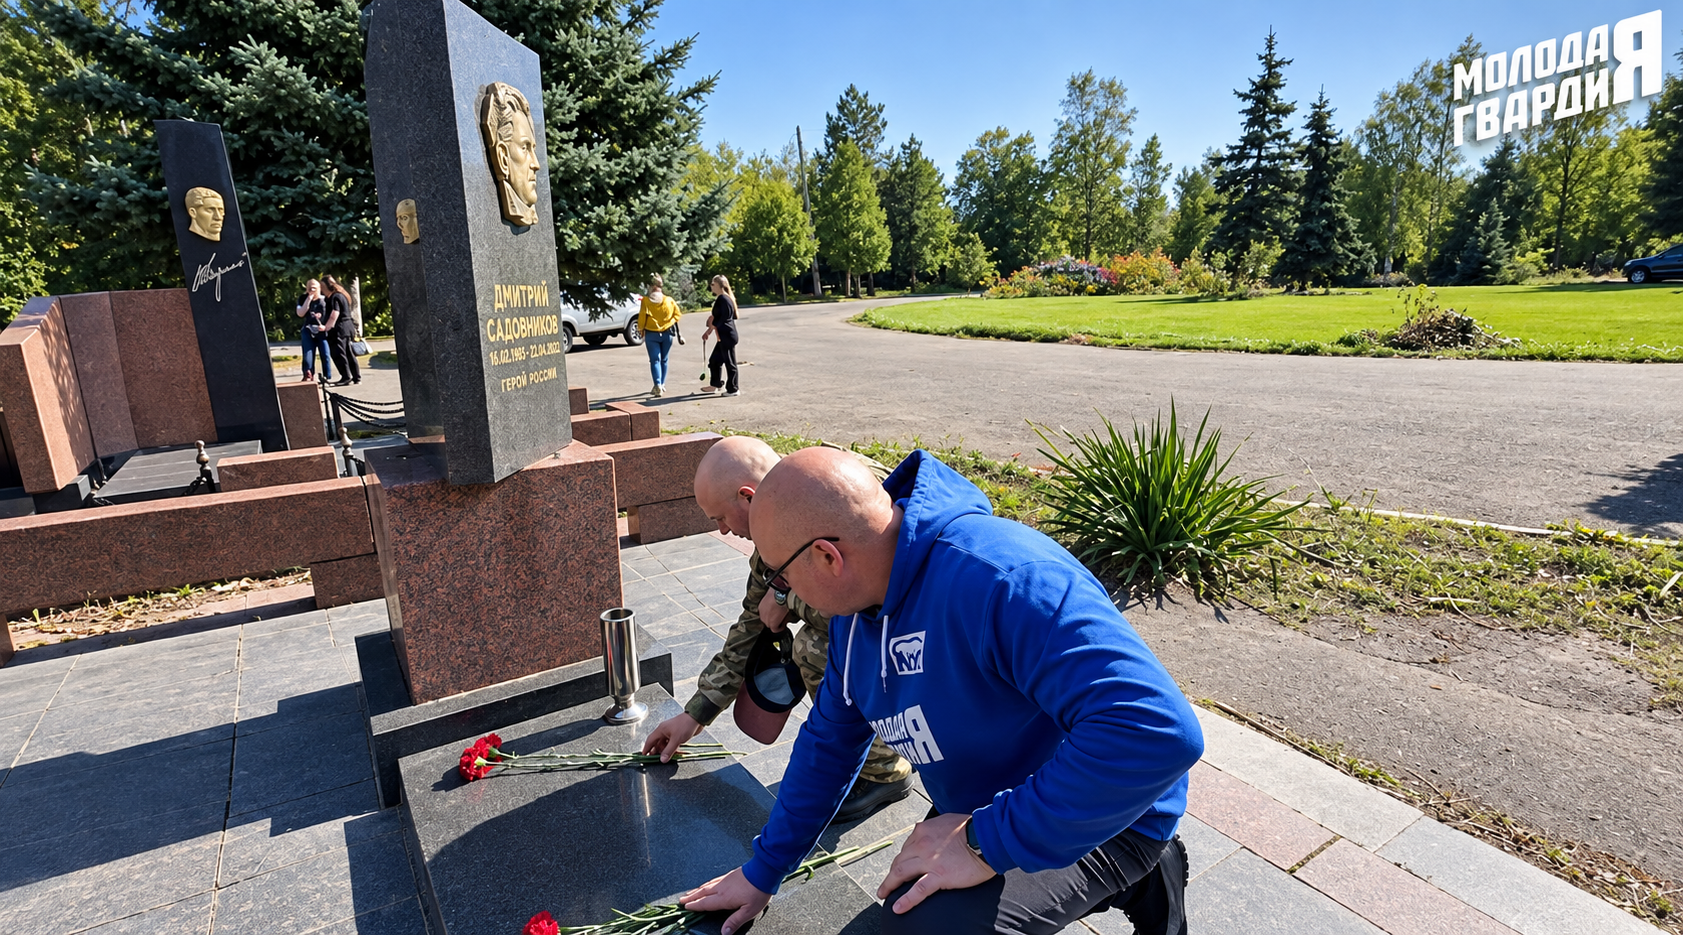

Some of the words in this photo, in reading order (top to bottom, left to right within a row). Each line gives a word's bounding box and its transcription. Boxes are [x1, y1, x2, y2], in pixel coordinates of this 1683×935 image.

[494, 280, 550, 313] ДМИТРИЙ
[486, 314, 559, 344] САДОВНИКОВ
[501, 371, 528, 392] ГЕРОЙ
[529, 367, 558, 384] РОССИИ
